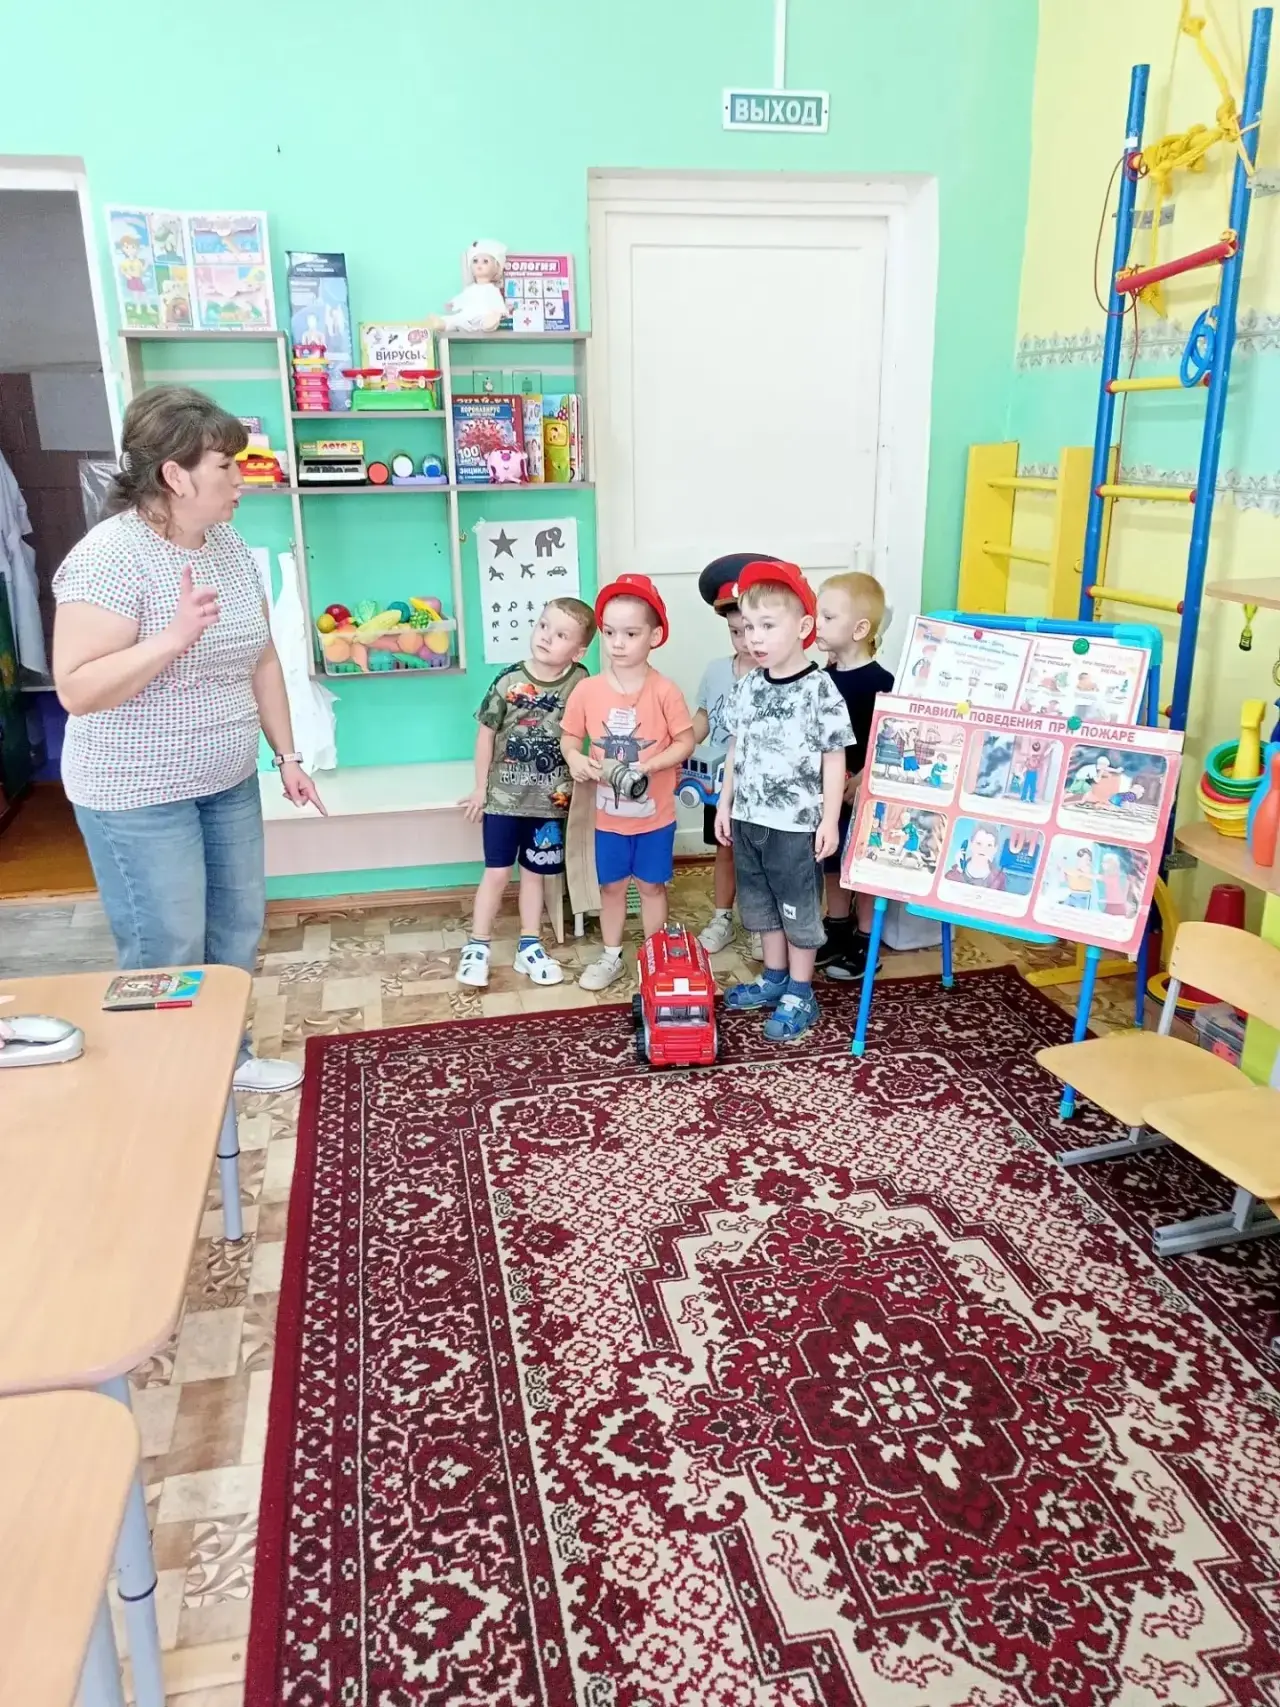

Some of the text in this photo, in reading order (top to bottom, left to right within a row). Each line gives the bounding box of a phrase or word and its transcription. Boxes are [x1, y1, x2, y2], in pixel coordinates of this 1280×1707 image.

[735, 98, 818, 125] ВЫХОД
[376, 350, 420, 360] ВИРУСЫ
[321, 442, 348, 450] ЛОТО
[458, 445, 479, 459] 100
[909, 702, 964, 720] ПРАВИЛА
[969, 711, 1043, 730] ПОВЕДЕНИЯ
[1080, 725, 1136, 743] ПОЖАРЕ
[526, 848, 563, 865] SONI
